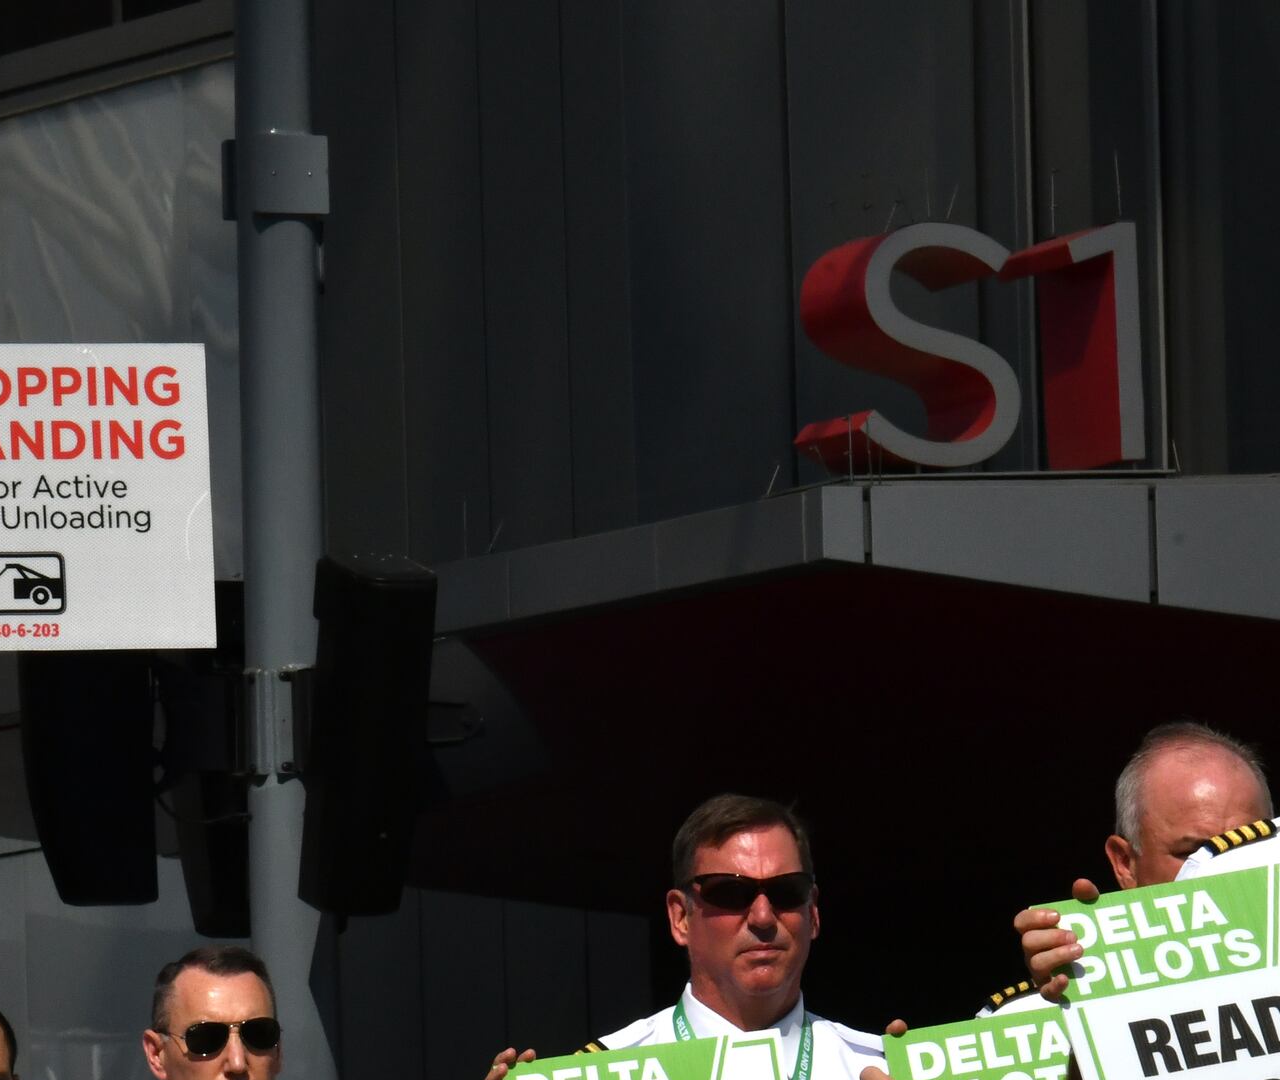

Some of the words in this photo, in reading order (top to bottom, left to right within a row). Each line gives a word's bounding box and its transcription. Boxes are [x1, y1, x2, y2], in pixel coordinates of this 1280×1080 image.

[794, 221, 1145, 470] S1
[33, 474, 128, 499] Active
[0, 505, 152, 533] Unloading
[1058, 890, 1229, 950] DELTA
[1072, 929, 1261, 996] PILOTS
